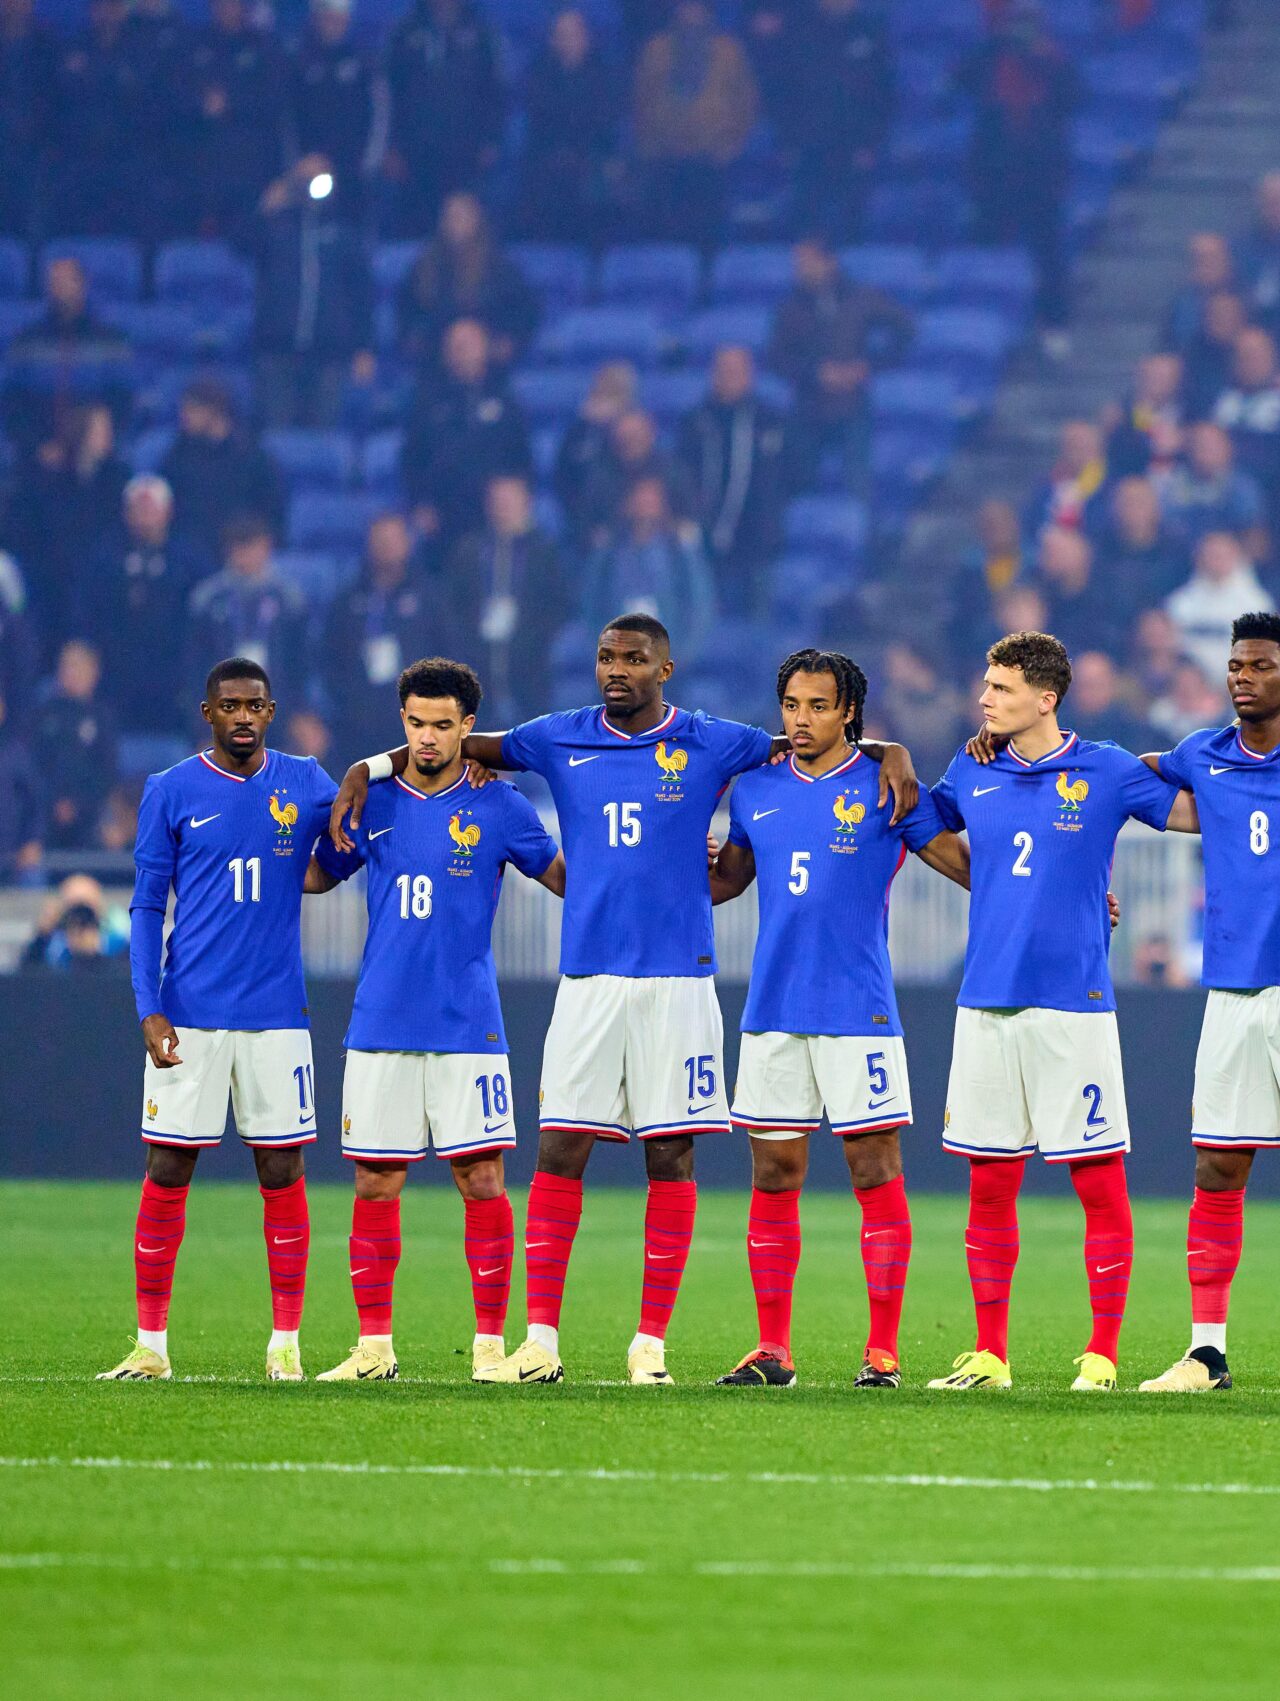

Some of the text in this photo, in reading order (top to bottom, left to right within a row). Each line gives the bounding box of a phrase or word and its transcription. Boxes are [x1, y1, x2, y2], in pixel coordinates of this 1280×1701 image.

[603, 802, 642, 848] 15
[1249, 810, 1269, 856] 8
[788, 851, 811, 896] 5
[1012, 831, 1033, 877] 2
[229, 858, 261, 903] 11
[396, 875, 433, 920] 18
[294, 1064, 314, 1109] 11
[476, 1073, 509, 1119] 18
[685, 1054, 717, 1100] 15
[867, 1052, 889, 1096] 5
[1083, 1084, 1107, 1126] 2
